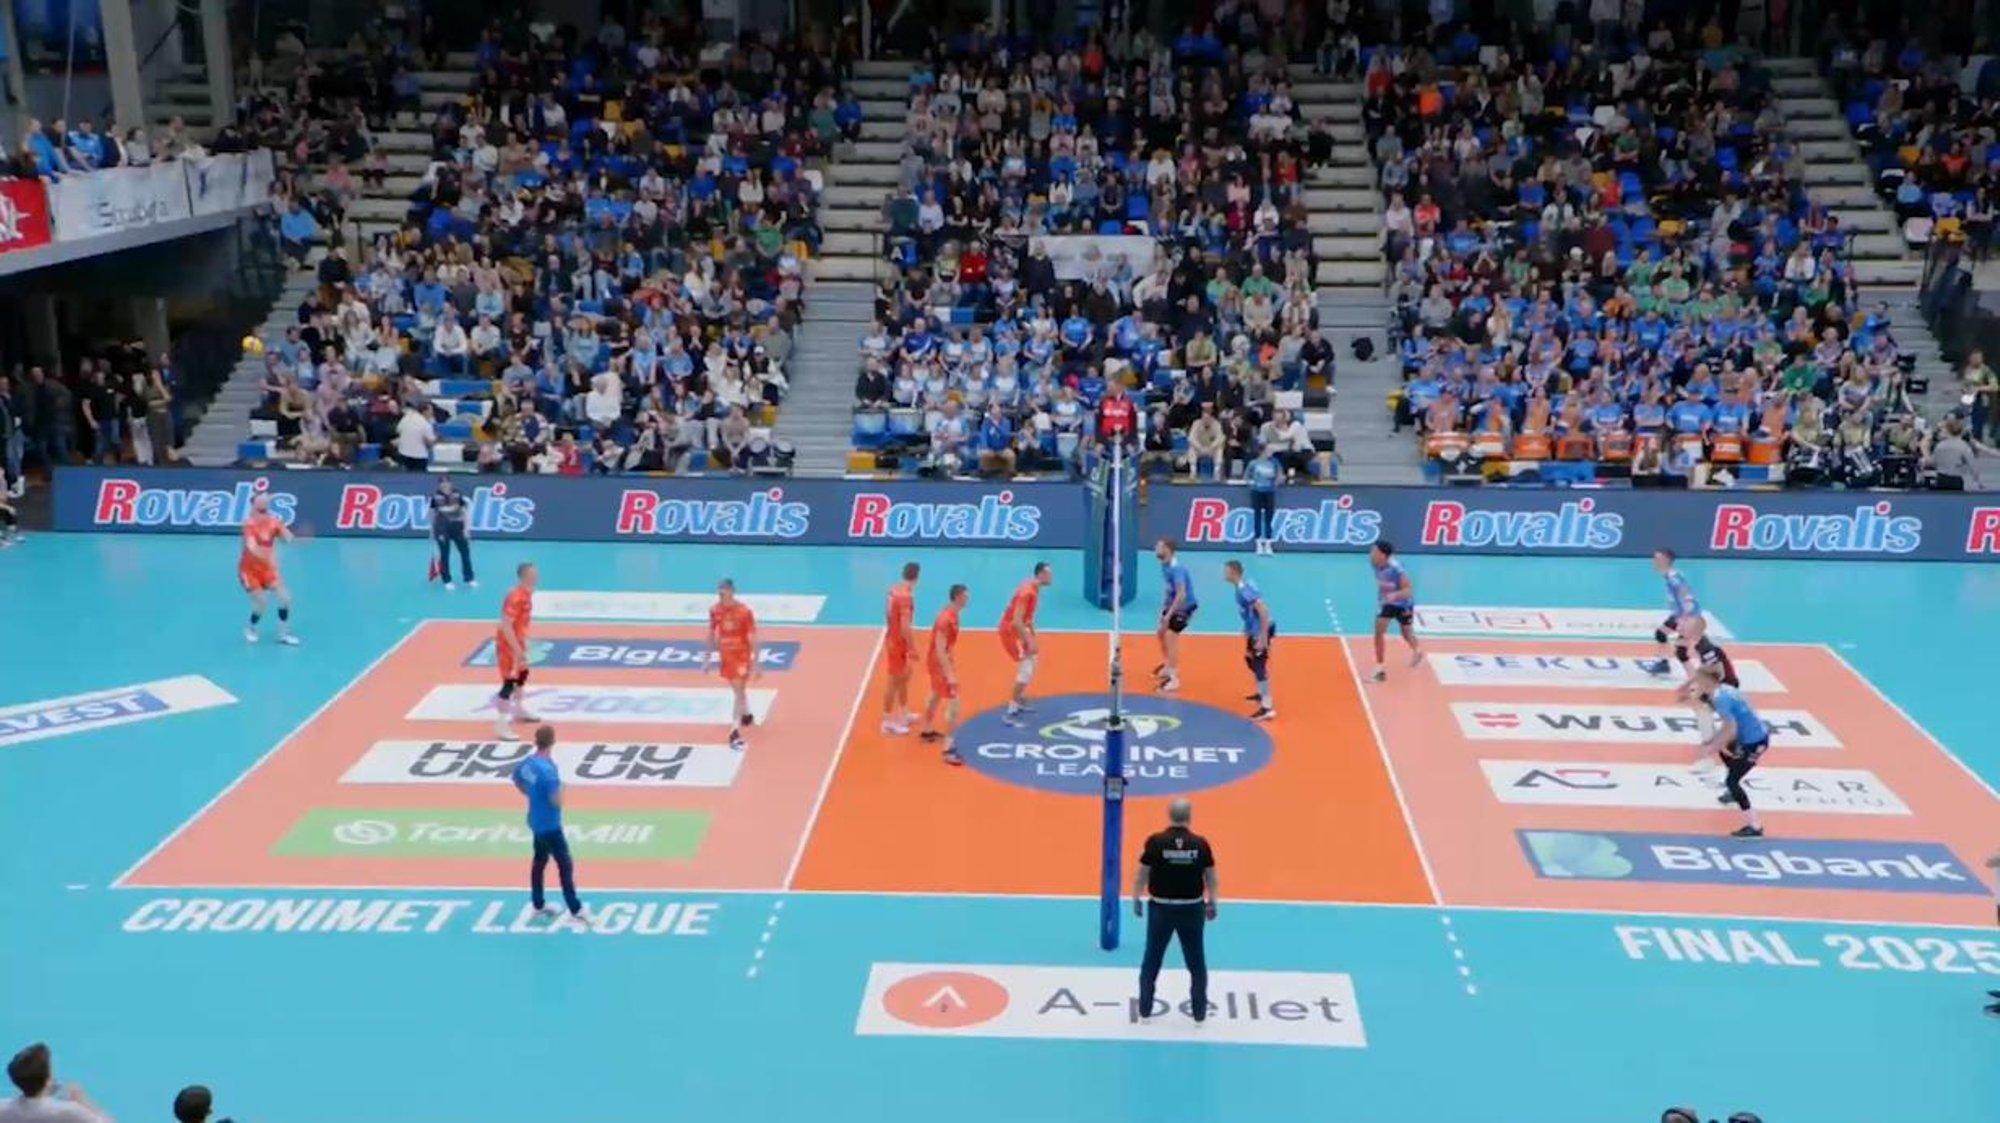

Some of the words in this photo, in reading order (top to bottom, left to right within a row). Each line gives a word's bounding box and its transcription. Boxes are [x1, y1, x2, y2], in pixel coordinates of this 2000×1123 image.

[337, 482, 535, 533] Rovlis
[617, 487, 810, 538] Rovalis
[848, 490, 1041, 540] Rovalis
[1421, 497, 1624, 548] Rovalis
[1710, 501, 1922, 552] Rovalis
[569, 645, 796, 665] Bigbak
[1538, 713, 1812, 736] WÜRH
[1650, 844, 1967, 882] Bigbank
[122, 898, 468, 932] CRONIMET
[471, 900, 719, 935] LEAGUE
[1614, 925, 1821, 968] FINAL
[1823, 934, 2000, 975] 2025
[1037, 987, 1344, 1024] A-pellet
